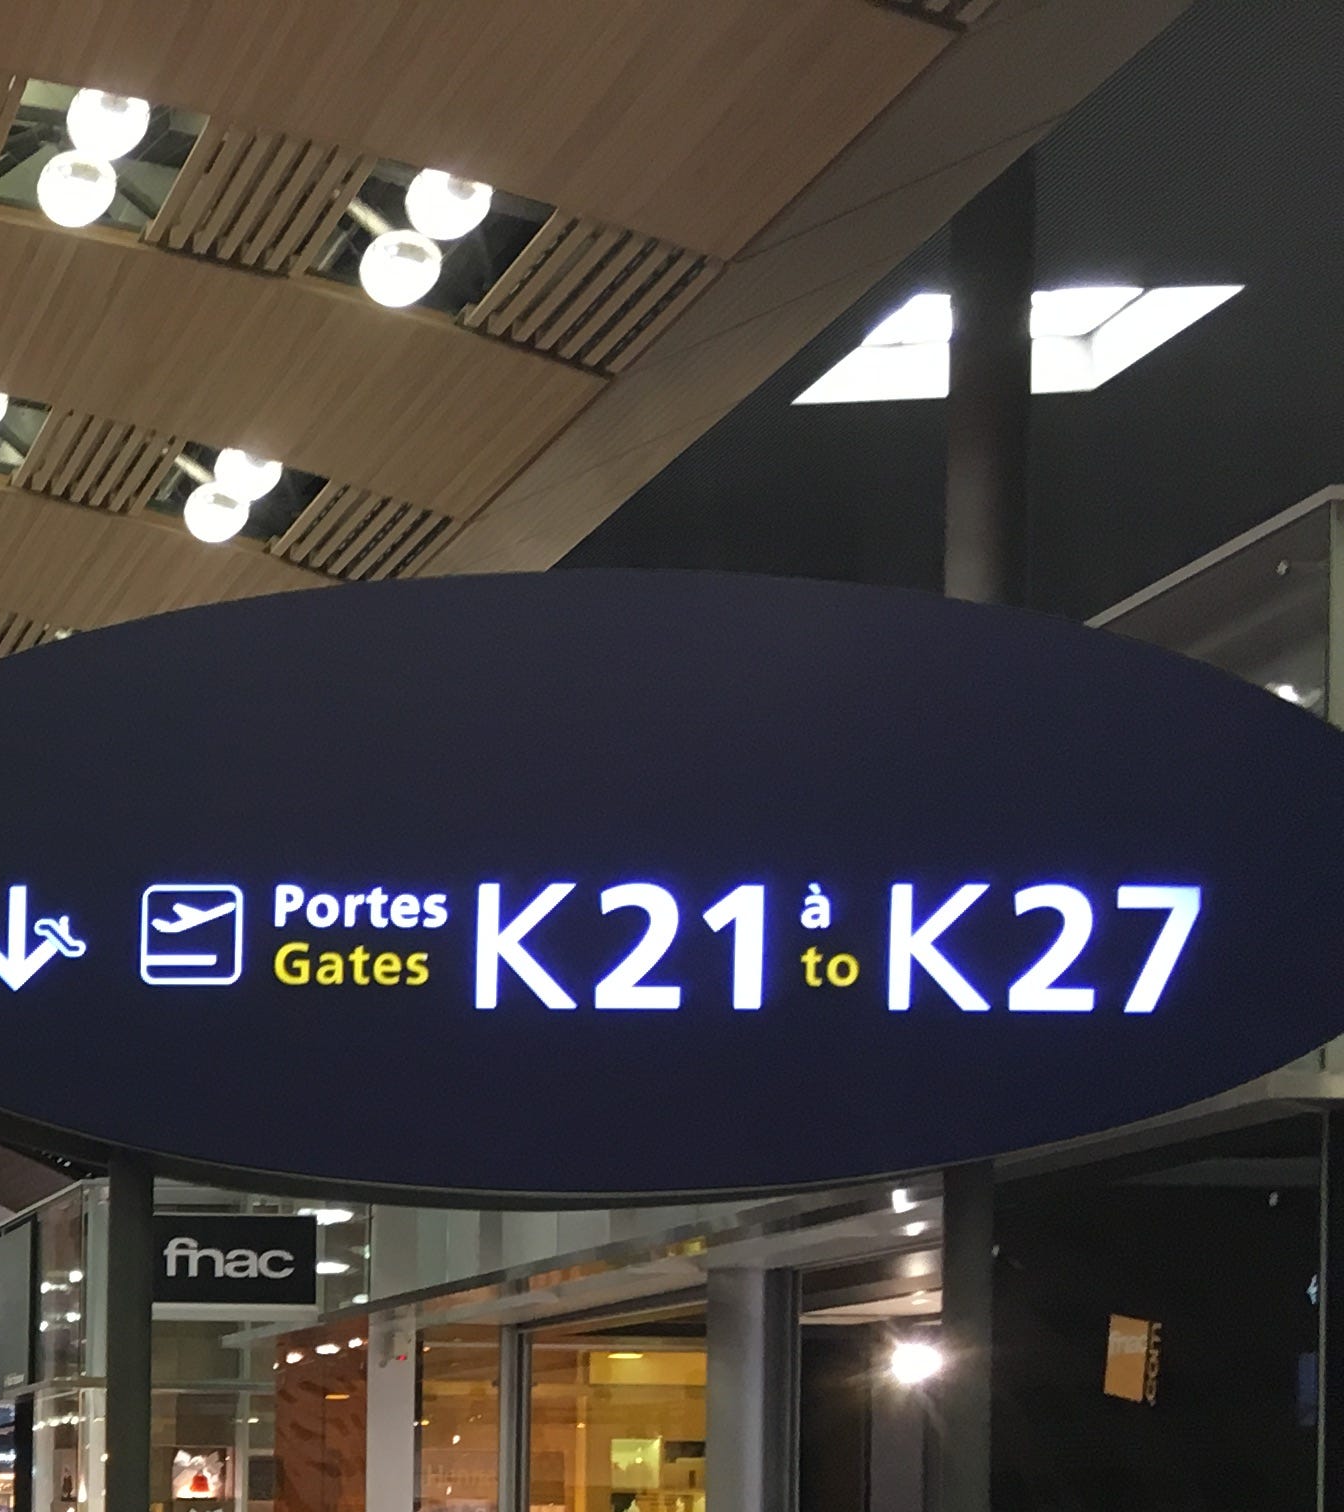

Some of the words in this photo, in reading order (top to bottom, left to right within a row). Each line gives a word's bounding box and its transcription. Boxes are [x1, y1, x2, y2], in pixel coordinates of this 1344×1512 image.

[273, 942, 430, 987] Gates
[800, 947, 859, 987] to
[274, 884, 449, 929] Portes
[473, 881, 767, 1010] K21
[800, 882, 832, 930] à
[887, 881, 1203, 1013] K27
[163, 1237, 295, 1279] fnac
